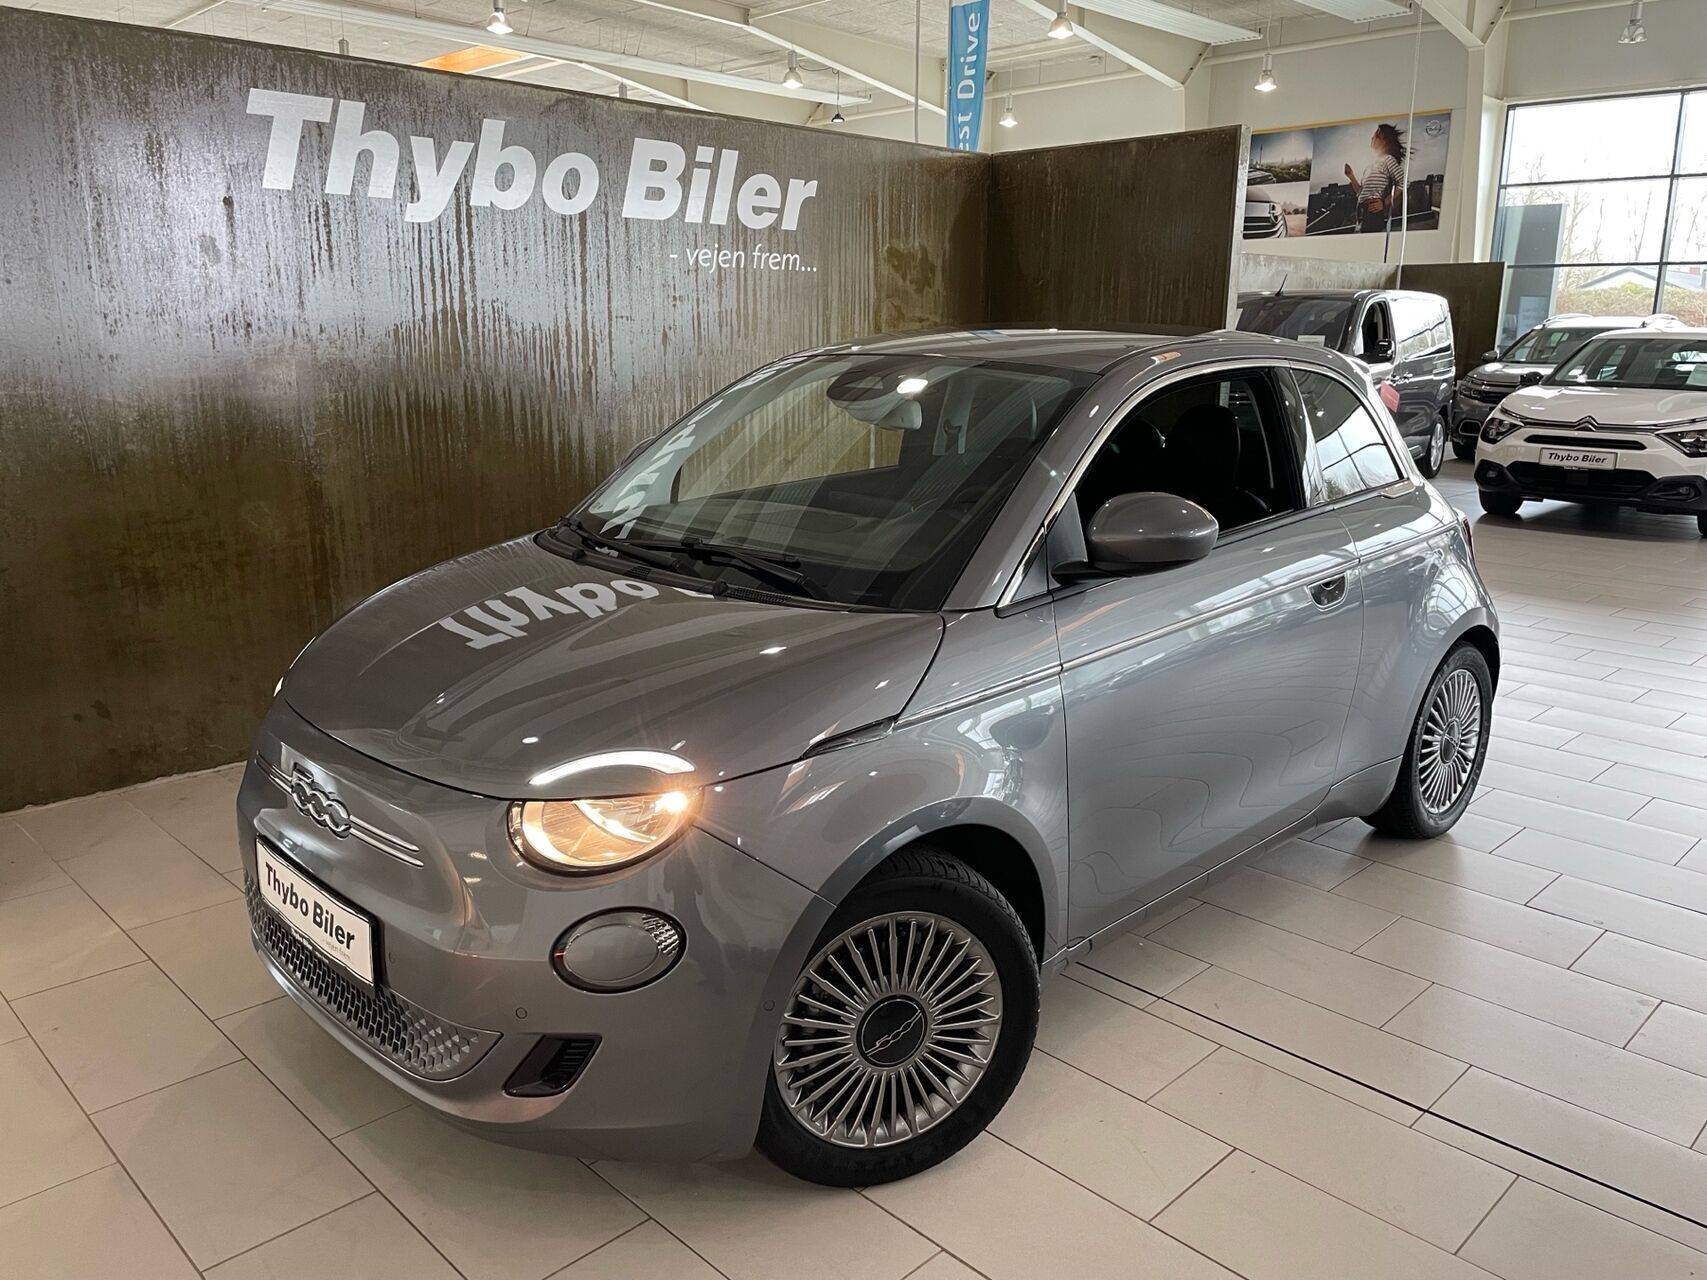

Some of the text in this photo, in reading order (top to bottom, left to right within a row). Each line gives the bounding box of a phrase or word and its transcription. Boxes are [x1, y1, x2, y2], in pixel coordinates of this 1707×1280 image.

[957, 12, 981, 99] Drive
[246, 87, 818, 231] Thybo Biler
[686, 243, 745, 273] vejen
[752, 244, 817, 272] frem...
[1548, 452, 1607, 464] Thybo Biler
[265, 862, 310, 917] Thybo
[312, 899, 356, 950] Biler
